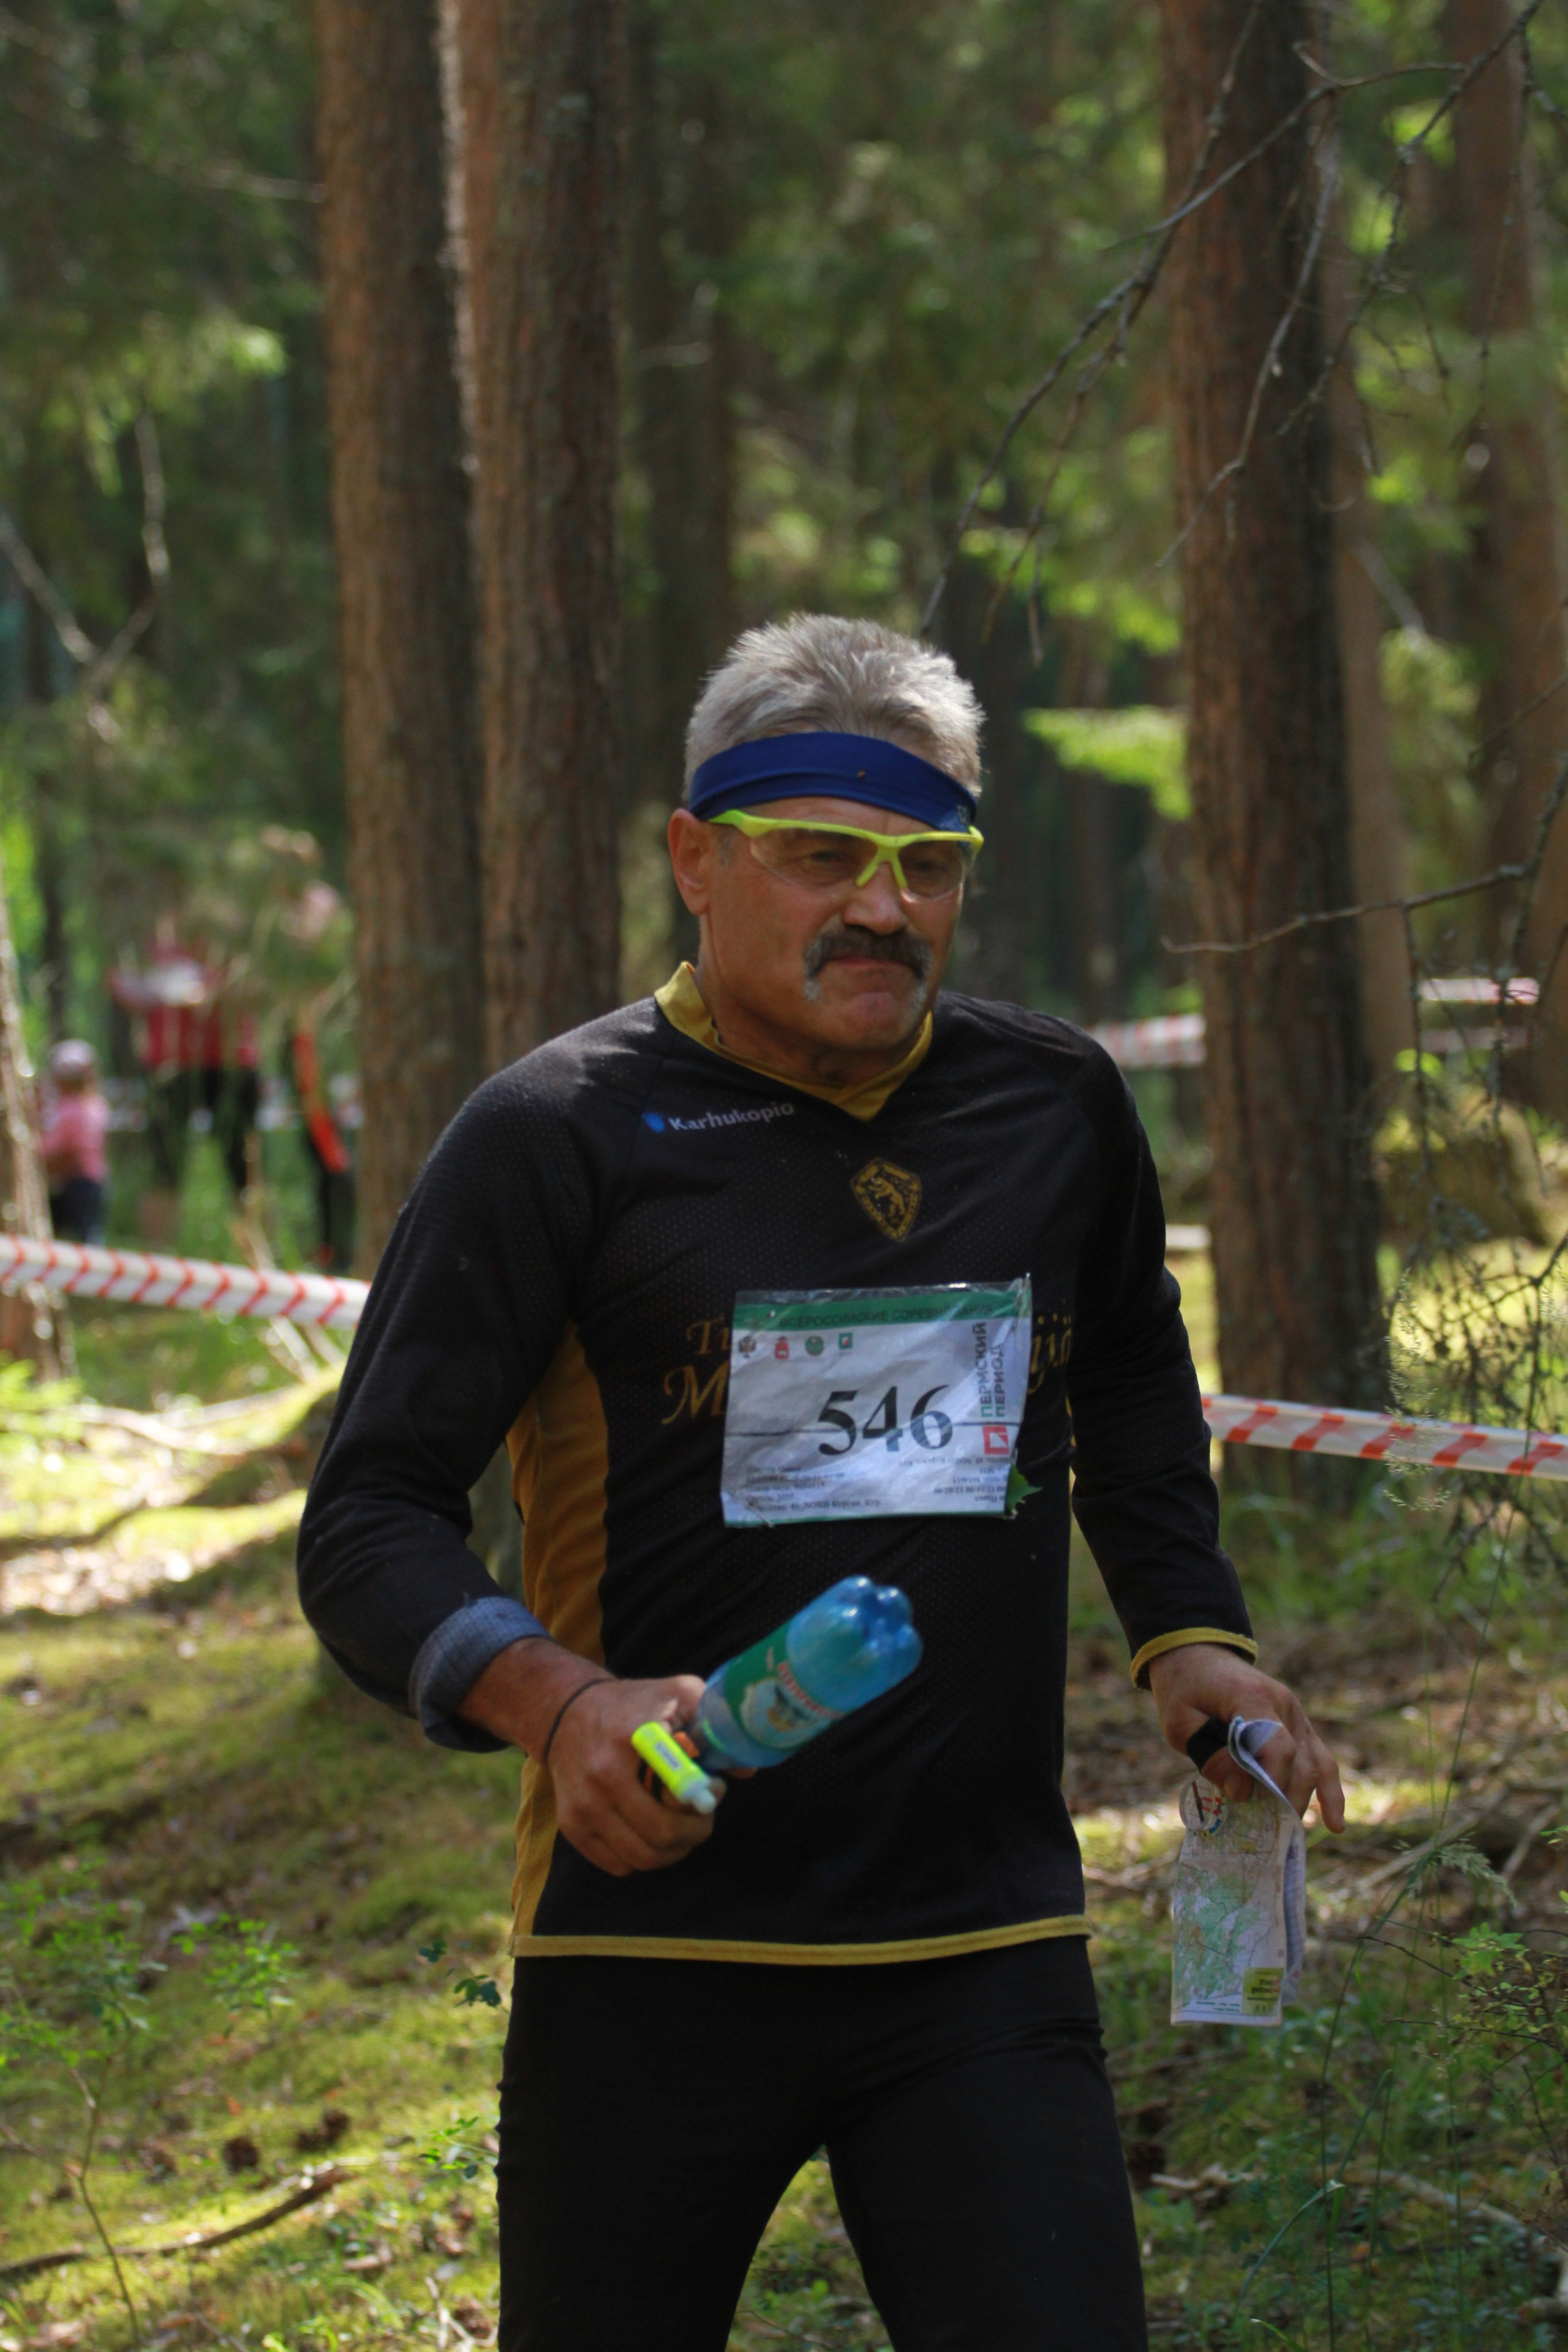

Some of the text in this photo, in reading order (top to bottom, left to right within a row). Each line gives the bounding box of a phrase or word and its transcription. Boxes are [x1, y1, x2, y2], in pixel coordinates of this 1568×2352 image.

[668, 1102, 794, 1130] Karhukopio
[973, 1322, 993, 1417] ПЕРМСКИЙ
[990, 1345, 1006, 1417] ПЕРИОД
[818, 1384, 953, 1456] 546
